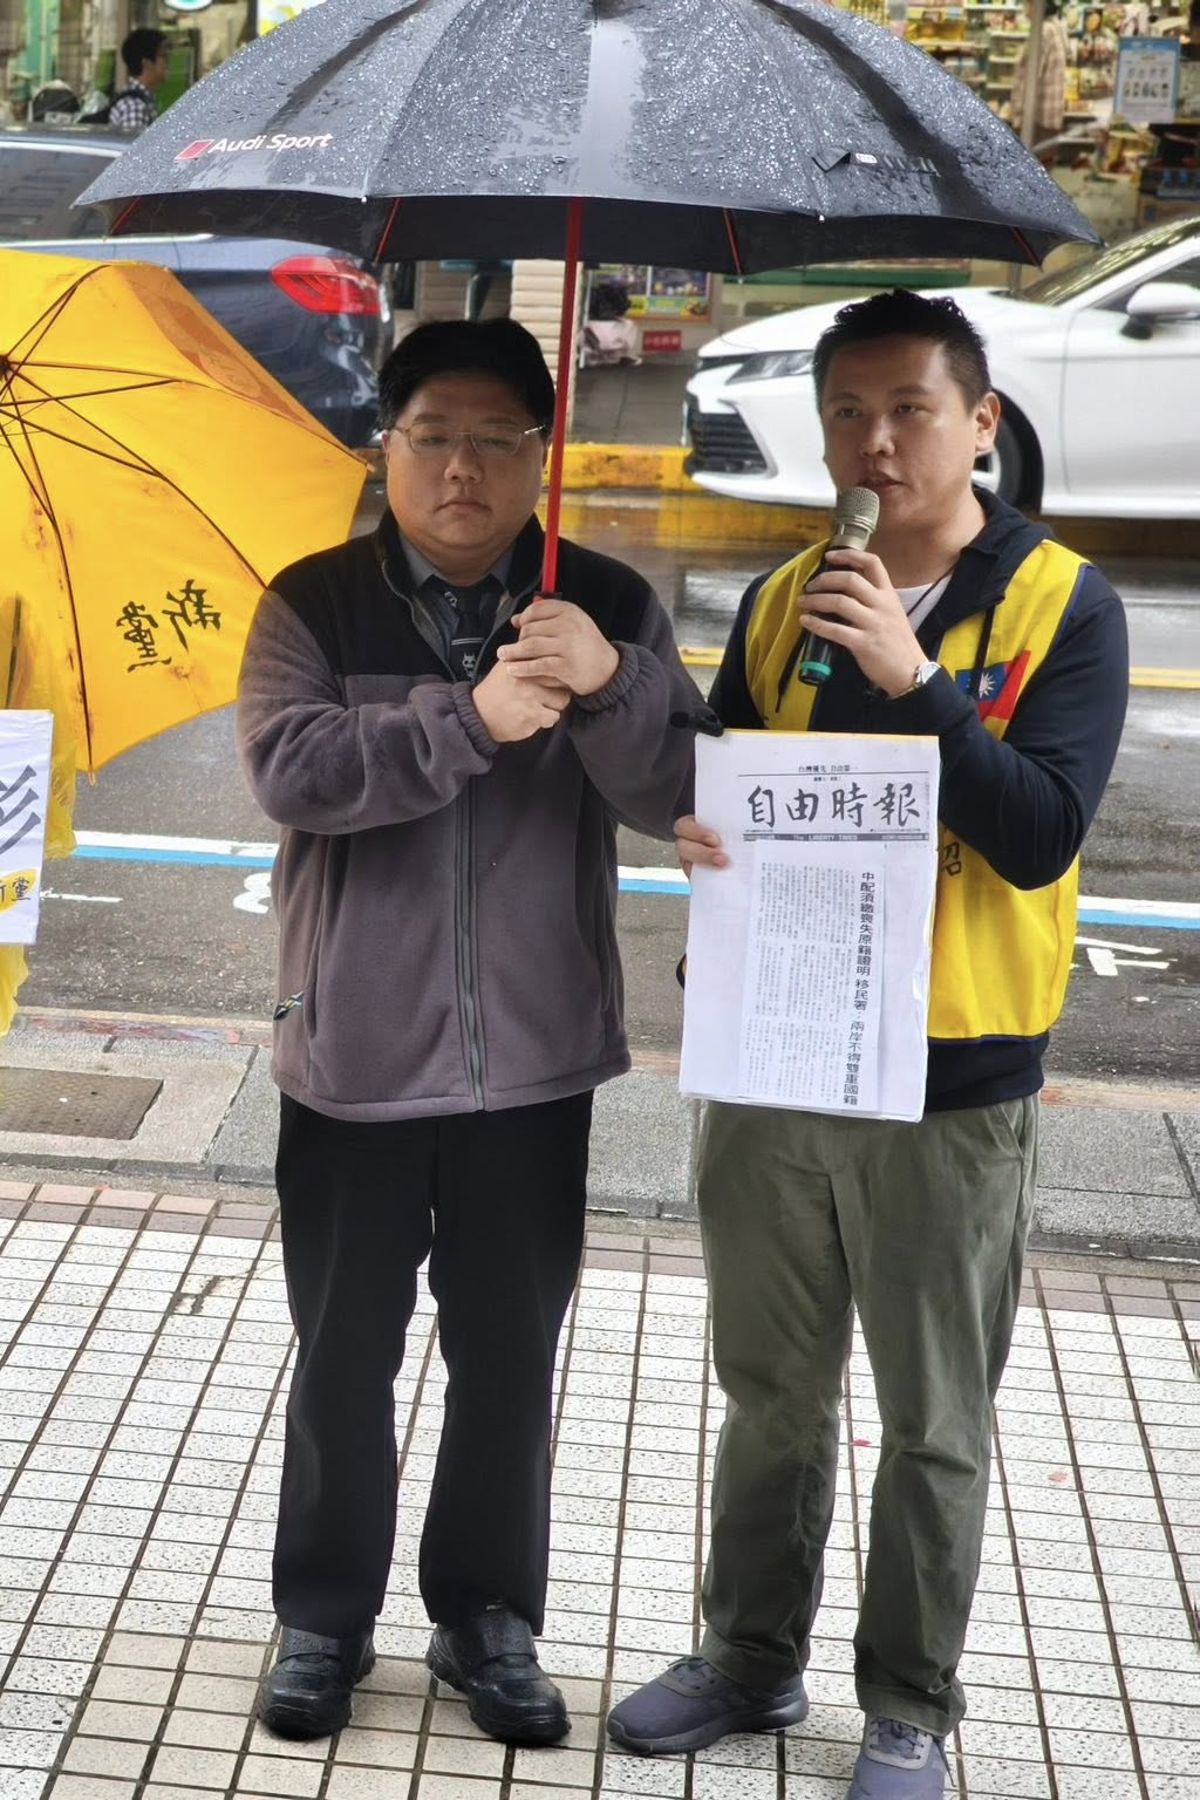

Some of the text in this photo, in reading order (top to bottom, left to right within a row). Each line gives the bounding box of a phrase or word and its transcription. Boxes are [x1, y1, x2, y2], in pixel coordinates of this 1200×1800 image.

[208, 133, 334, 154] Audi Sport
[747, 782, 921, 828] 自由時報
